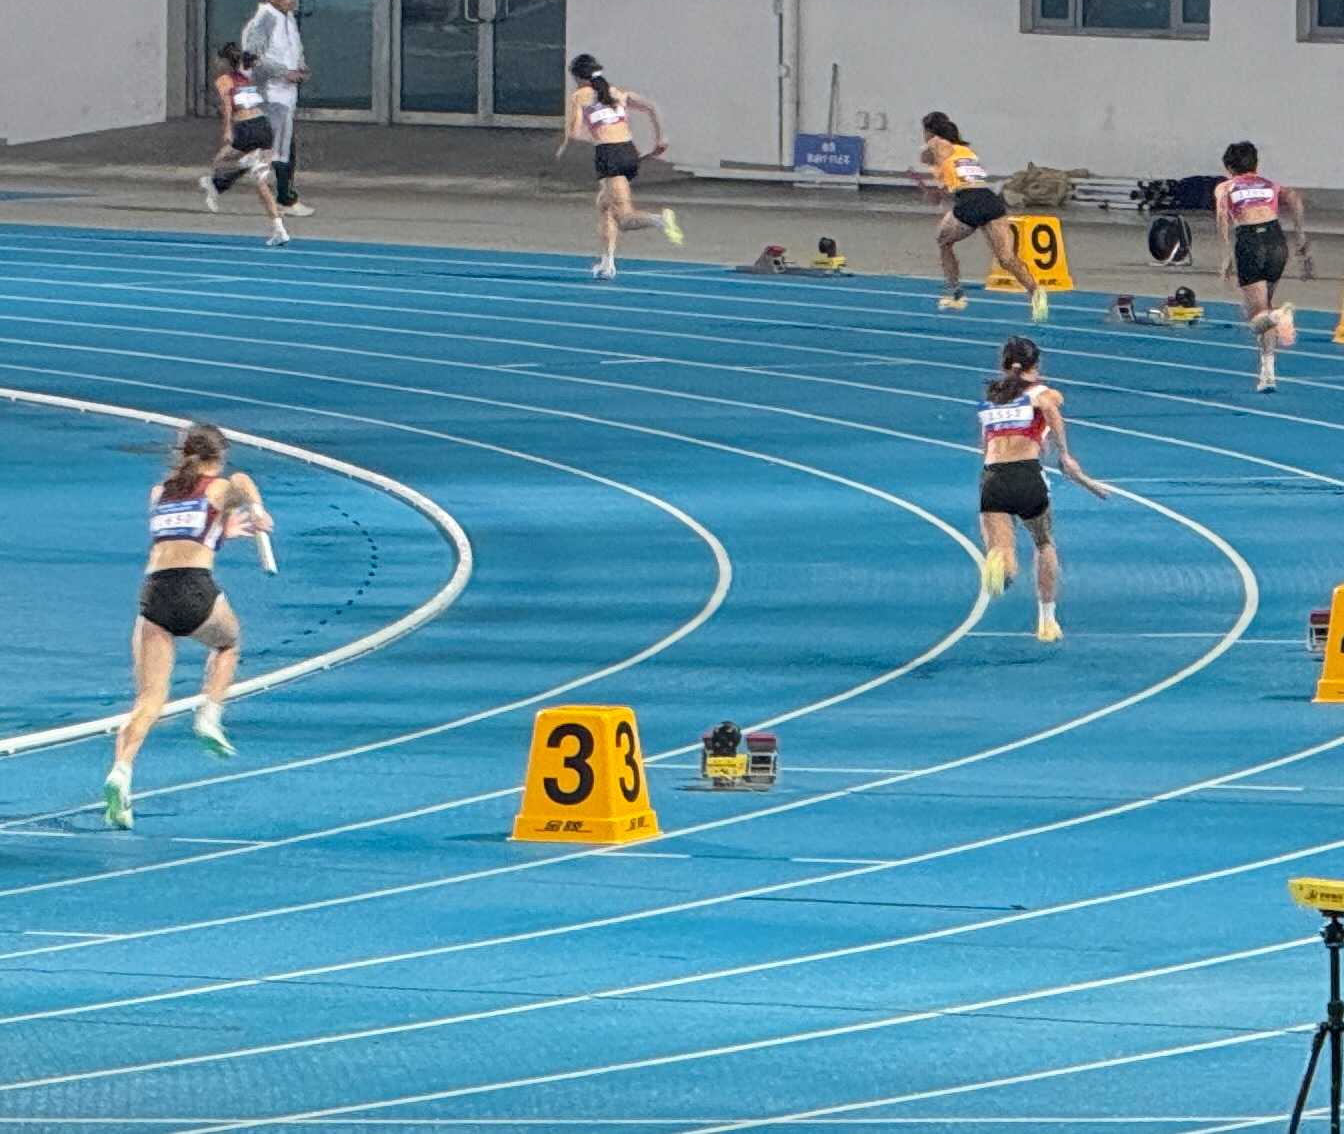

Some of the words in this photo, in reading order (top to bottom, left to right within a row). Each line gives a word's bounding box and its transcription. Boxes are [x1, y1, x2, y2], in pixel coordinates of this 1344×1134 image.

[1031, 223, 1058, 270] 9
[543, 722, 595, 806] 3
[615, 720, 641, 803] 3
